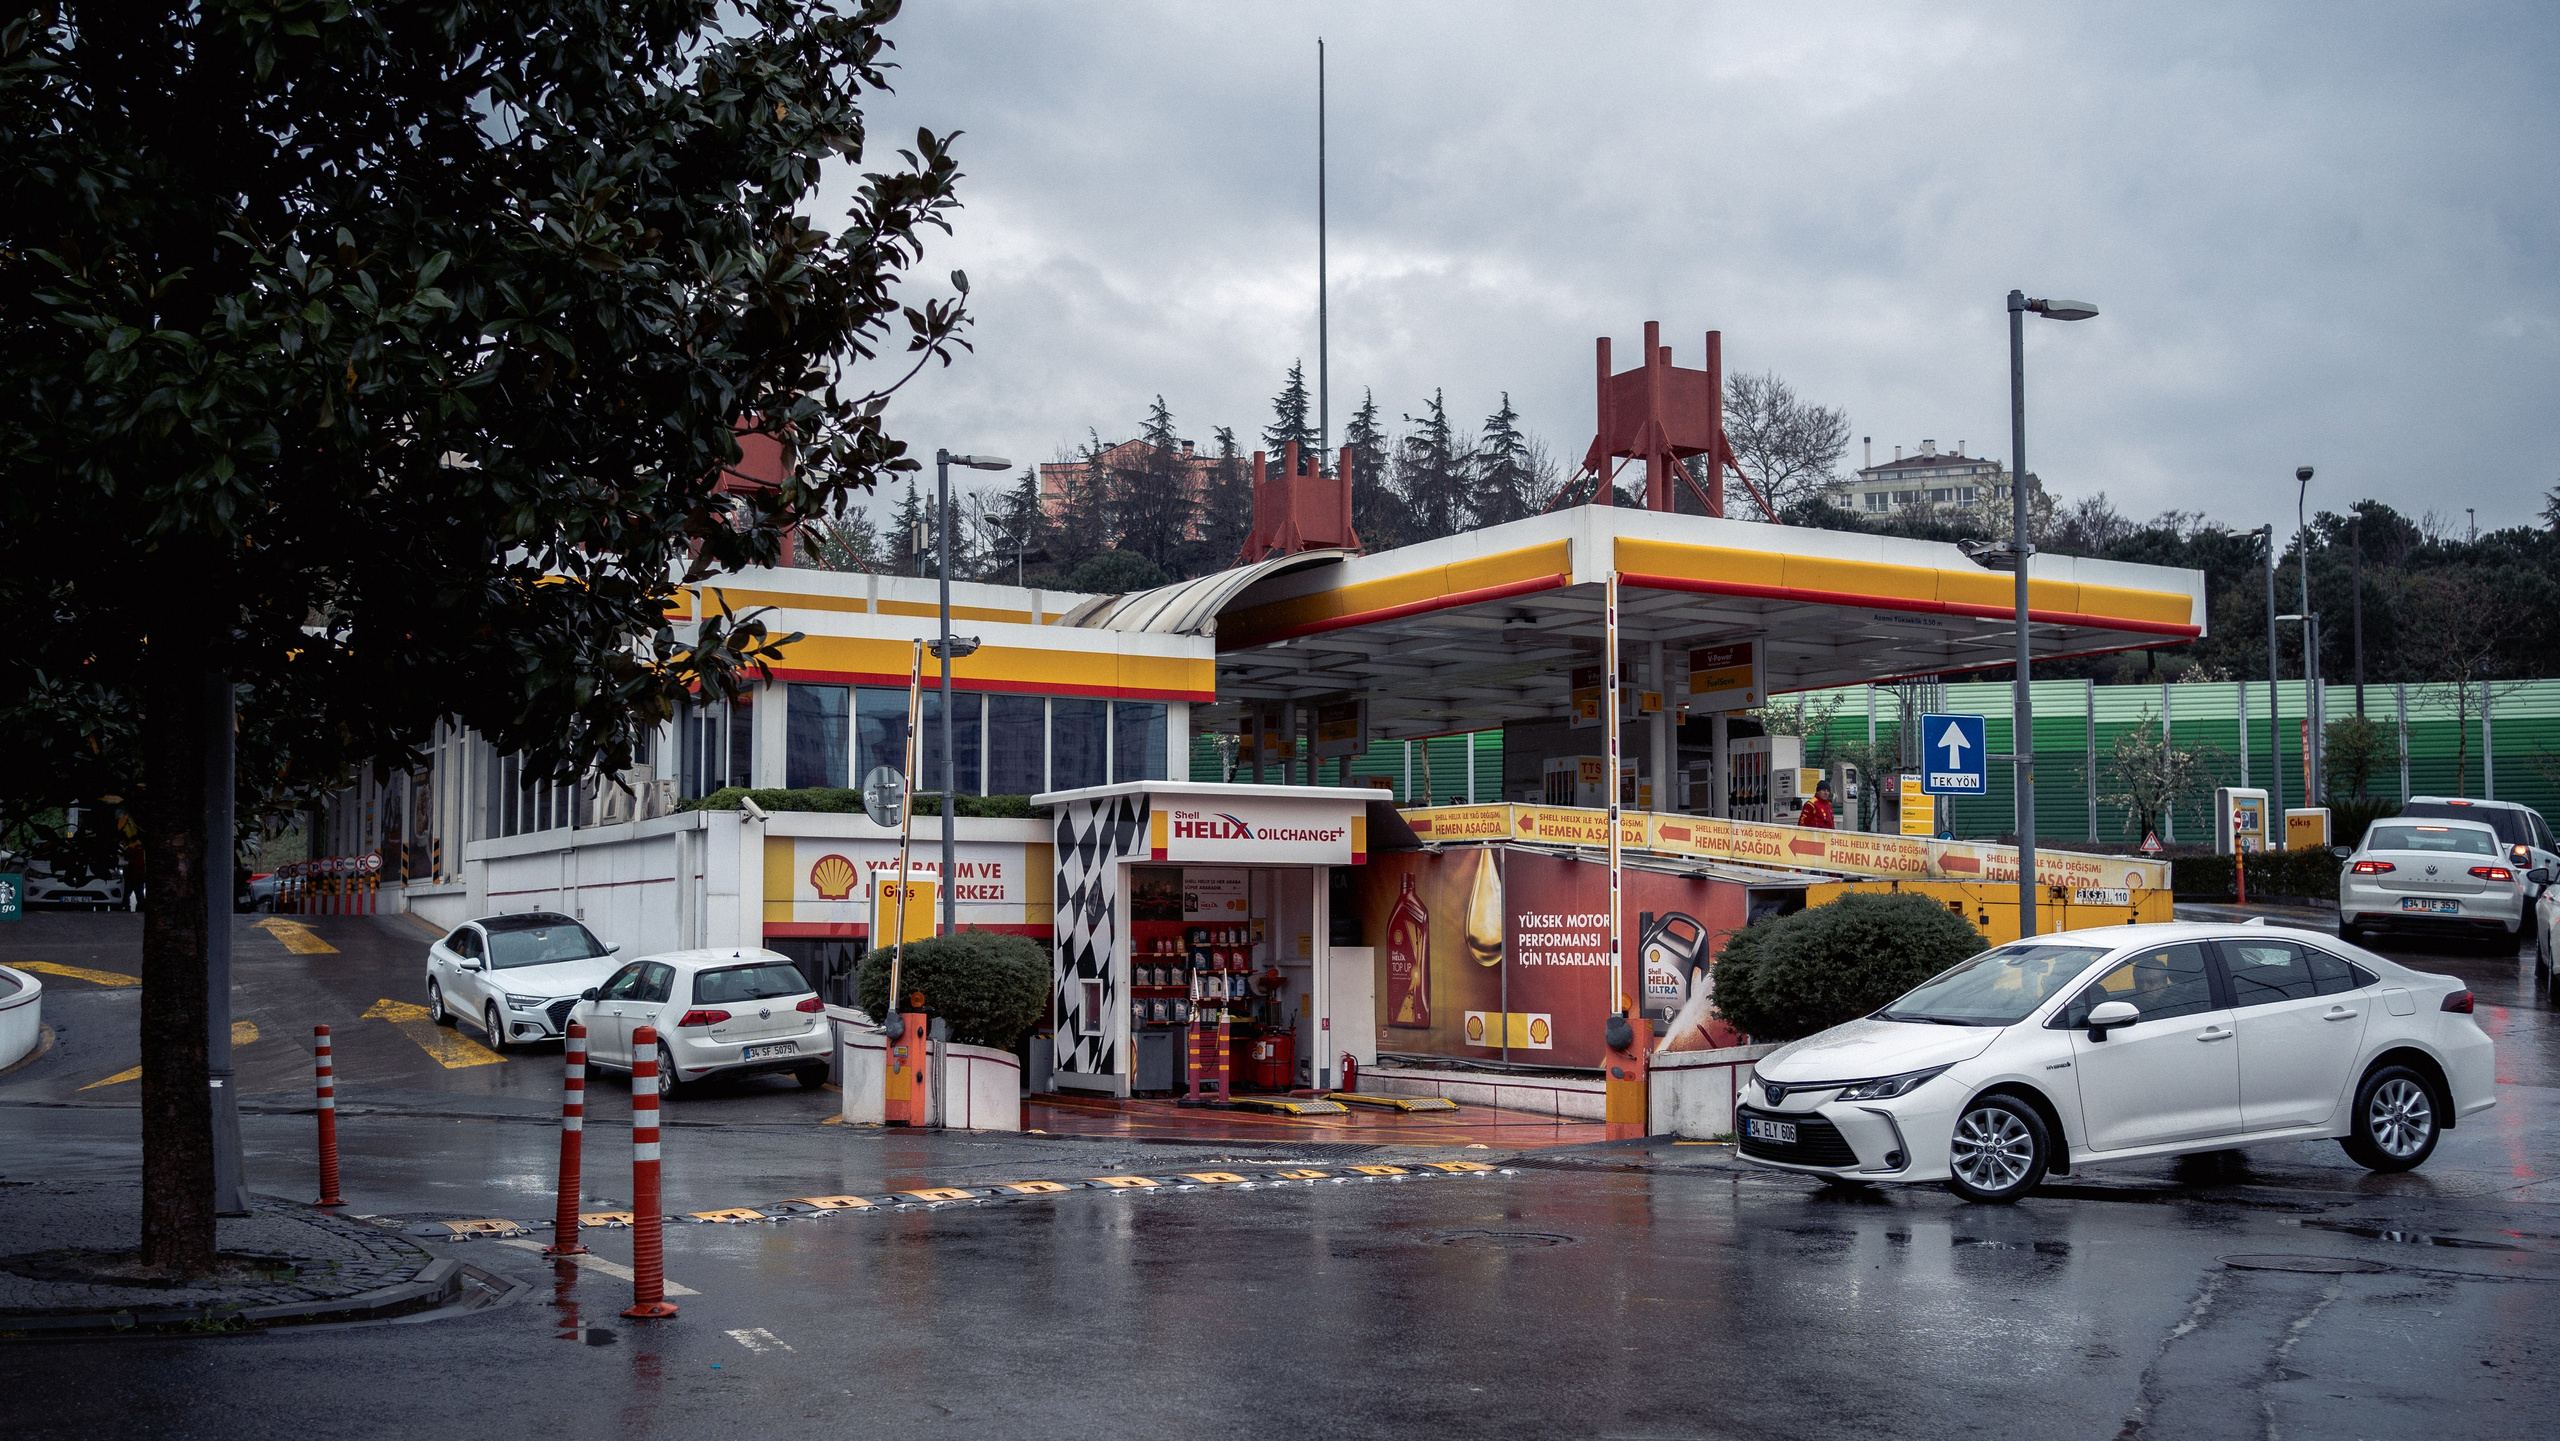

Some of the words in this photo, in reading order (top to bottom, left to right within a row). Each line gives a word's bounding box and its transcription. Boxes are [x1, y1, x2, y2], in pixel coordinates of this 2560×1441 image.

[1894, 615, 1921, 624] Yükseklik
[1708, 654, 1732, 662] V-Power
[1707, 678, 1735, 686] FuelSave
[1588, 704, 1595, 715] 3
[1582, 762, 1601, 774] TTS
[1932, 777, 1952, 786] TEK
[1956, 776, 1977, 787] YÖN
[1174, 810, 1200, 819] Shell
[1470, 811, 1479, 819] YAĞ
[1174, 820, 1253, 839] HELIX
[1436, 823, 1463, 835] HEMEN
[1465, 820, 1501, 836] AŞAĞIDA
[2290, 818, 2311, 828] Çıkış
[1539, 824, 1581, 838] HEMEN
[1586, 828, 1643, 842] AŞAIDA
[1695, 824, 1712, 833] SHELL
[1713, 826, 1729, 835] HELIX
[1741, 827, 1754, 837] YAĞ
[1695, 836, 1730, 850] HEMEN
[1734, 838, 1781, 856] AŞAĞIDA
[1830, 838, 1848, 848] SHELL
[1850, 840, 1869, 849] HELIX
[1882, 842, 1897, 852] YAĞ
[1830, 850, 1870, 866] HEMEN
[1874, 854, 1928, 872] AŞAĞIDA
[1986, 854, 2008, 864] SHELL
[2047, 859, 2063, 869] YAĞ
[978, 863, 1001, 878] VE
[1986, 867, 2019, 881] HEME
[883, 885, 915, 901] Giiş
[2115, 892, 2127, 901] 110
[2, 904, 15, 913] go
[2408, 899, 2418, 908] 34
[2440, 901, 2456, 910] 353
[1519, 911, 1563, 928] YÜKSEK
[1566, 914, 1610, 928] MOTOR
[1519, 933, 1600, 947] PERFORMANSI
[1519, 949, 1542, 968] İÇİN
[1392, 962, 1403, 972] TOP
[1404, 963, 1412, 972] UP
[1648, 975, 1679, 985] HELIX
[1648, 986, 1678, 994] ULTRA
[750, 1048, 760, 1058] 34
[762, 1047, 771, 1056] SF
[774, 1044, 792, 1055] 5079
[1751, 1121, 1760, 1136] 34
[1764, 1122, 1778, 1138] ELY
[1782, 1125, 1795, 1140] 606
